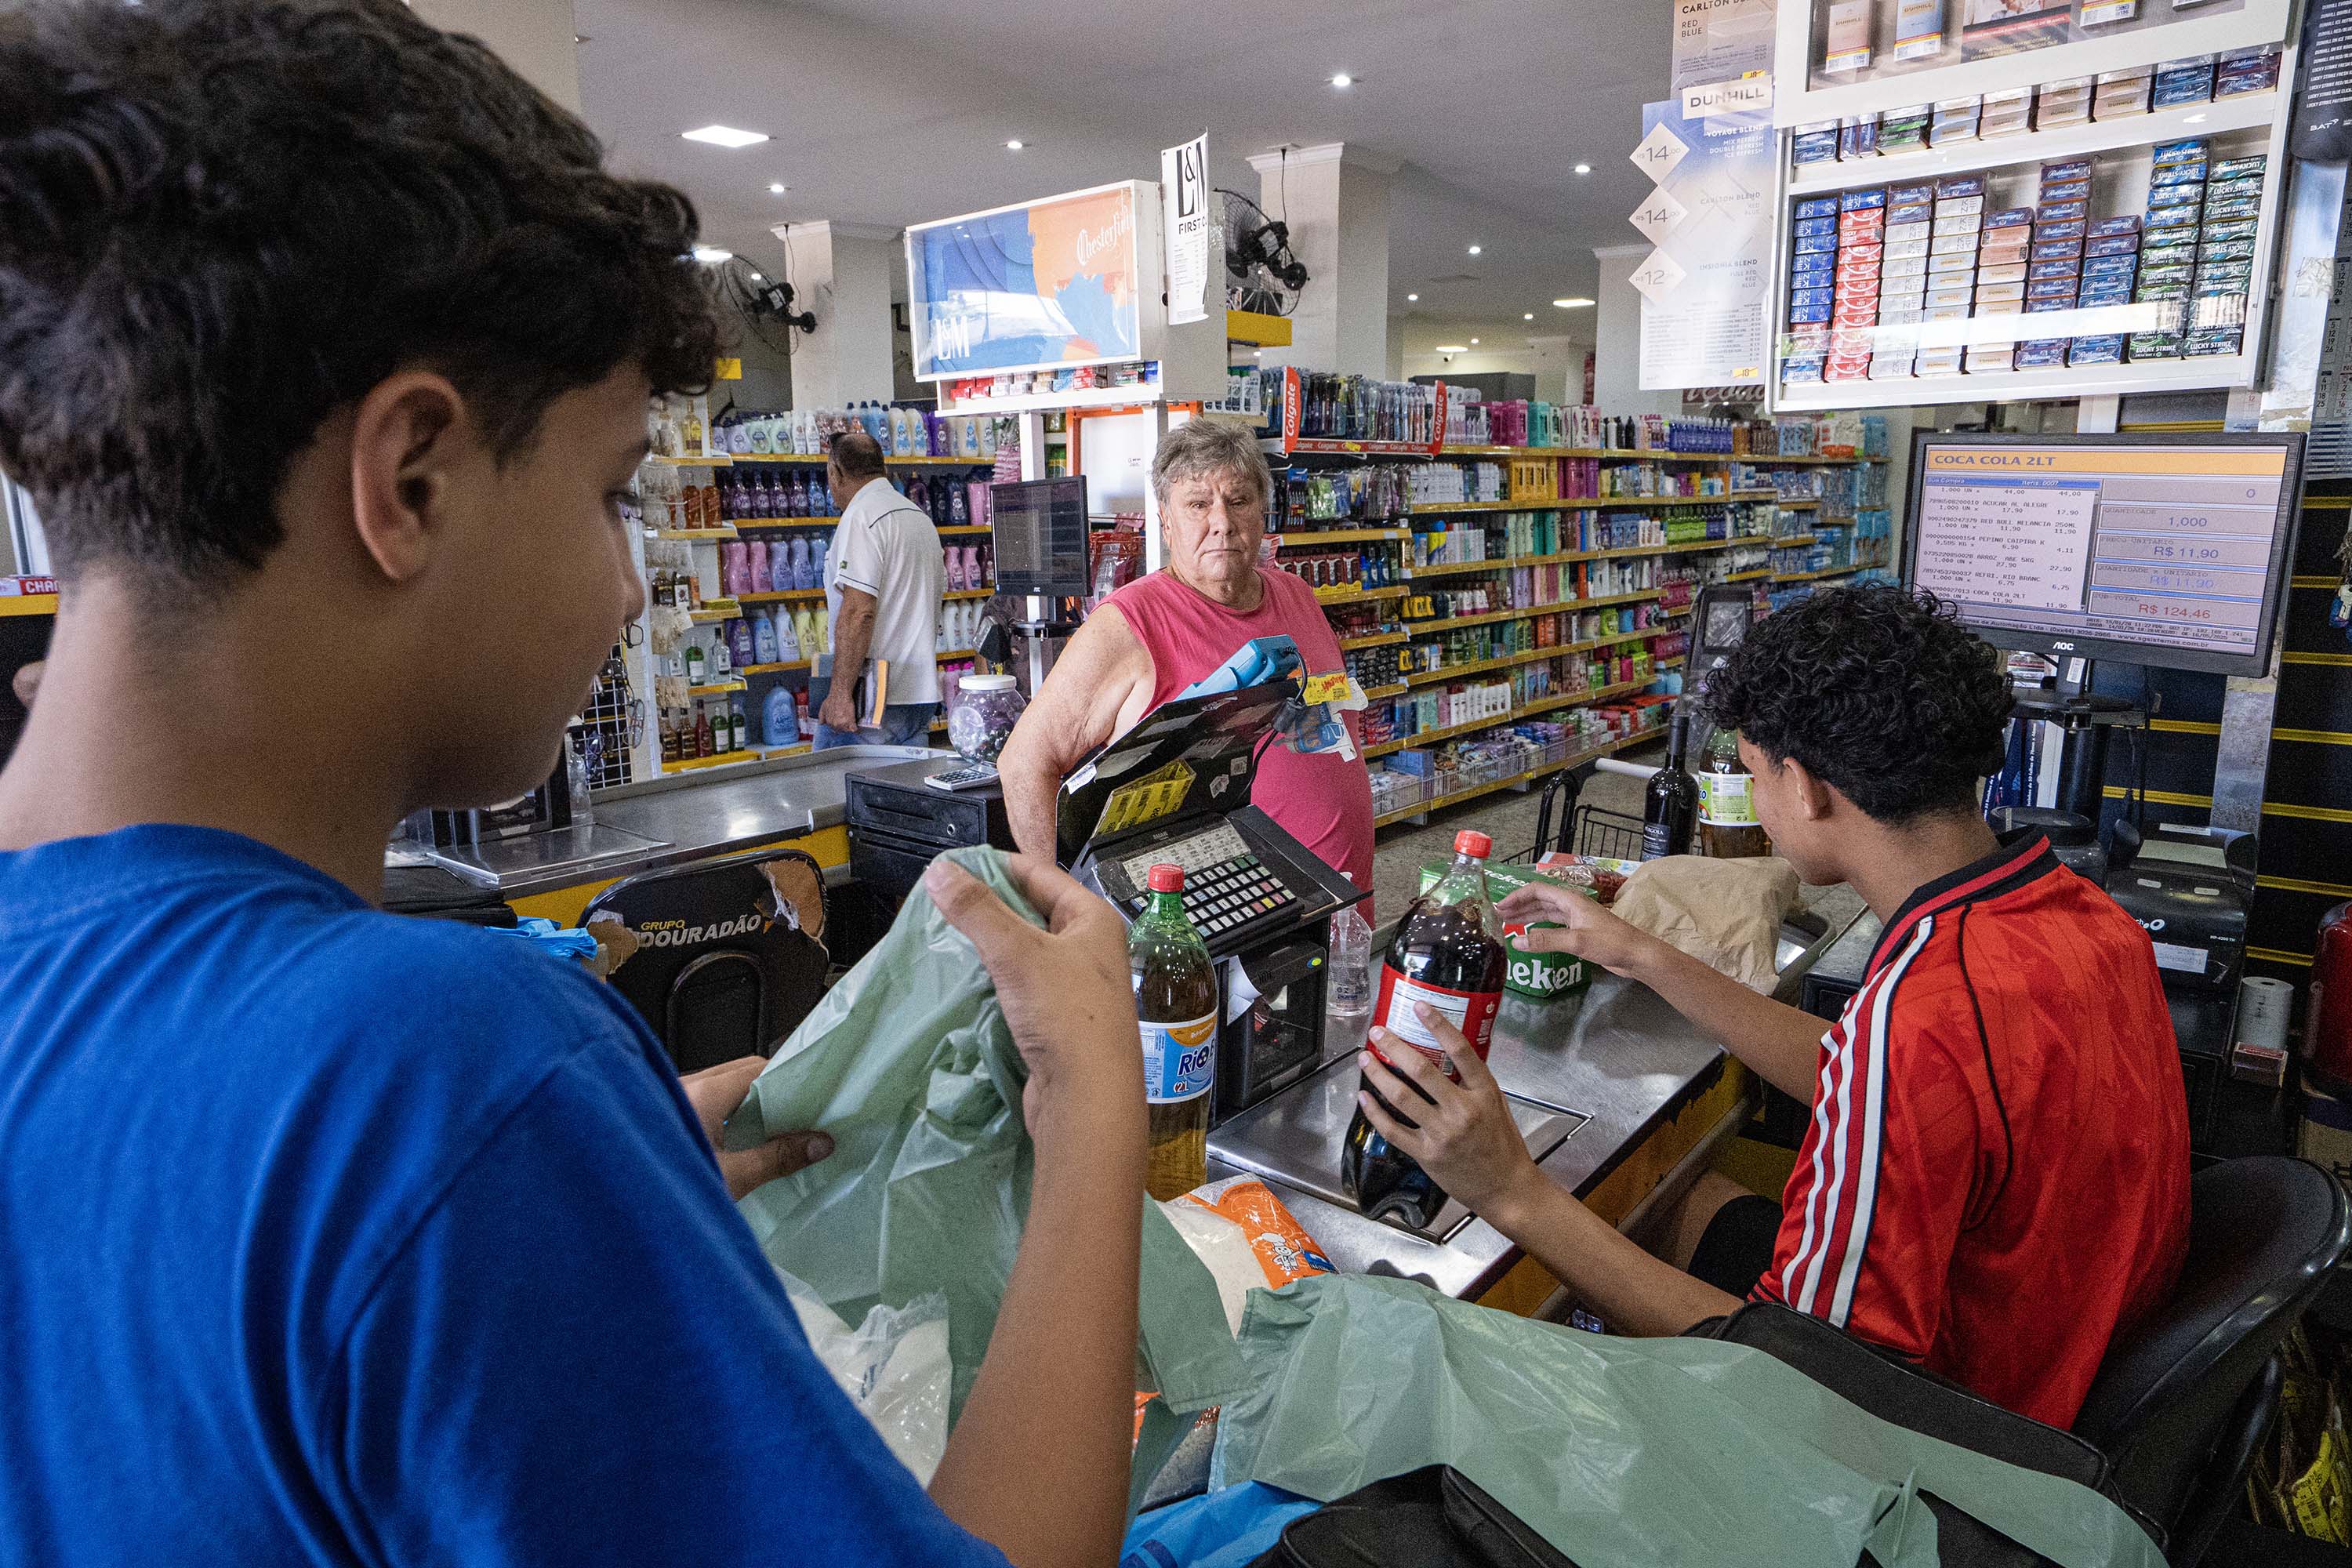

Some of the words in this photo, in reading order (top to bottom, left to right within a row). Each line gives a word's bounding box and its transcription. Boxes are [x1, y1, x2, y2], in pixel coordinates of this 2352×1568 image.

[1682, 20, 1698, 28] RED
[1682, 27, 1703, 38] BLUE
[1690, 88, 1765, 108] DUNHILL
[1707, 128, 1737, 138] VOYAGE
[1739, 125, 1764, 133] BLEND
[2310, 122, 2332, 131] BAT
[1737, 136, 1763, 144] REFRESH
[1737, 142, 1763, 151] REFRESH
[1737, 191, 1761, 201] BLEND
[2211, 205, 2230, 215] LUCKY
[2232, 203, 2254, 212] STRIKE
[1179, 218, 1201, 235] FIRST
[2169, 250, 2189, 259] STRIKE
[1734, 259, 1758, 267] BLEND
[935, 315, 970, 360] L&M
[1287, 383, 1296, 437] Colgate
[1434, 394, 1443, 441] Colgate
[1934, 455, 1975, 465] COCA
[1980, 456, 2020, 465] COLA
[2026, 456, 2056, 466] 2LT
[2169, 517, 2208, 528] 1,000
[2154, 546, 2174, 557] R$
[2097, 565, 2149, 574] QUANTIDADE
[2150, 575, 2170, 586] R$
[2139, 604, 2159, 615] R$
[1991, 620, 2027, 630] Automação
[2053, 641, 2074, 651] AOC
[638, 914, 761, 948] DOURADÃO
[641, 920, 685, 931] GRUPO
[1506, 959, 1582, 990] eken
